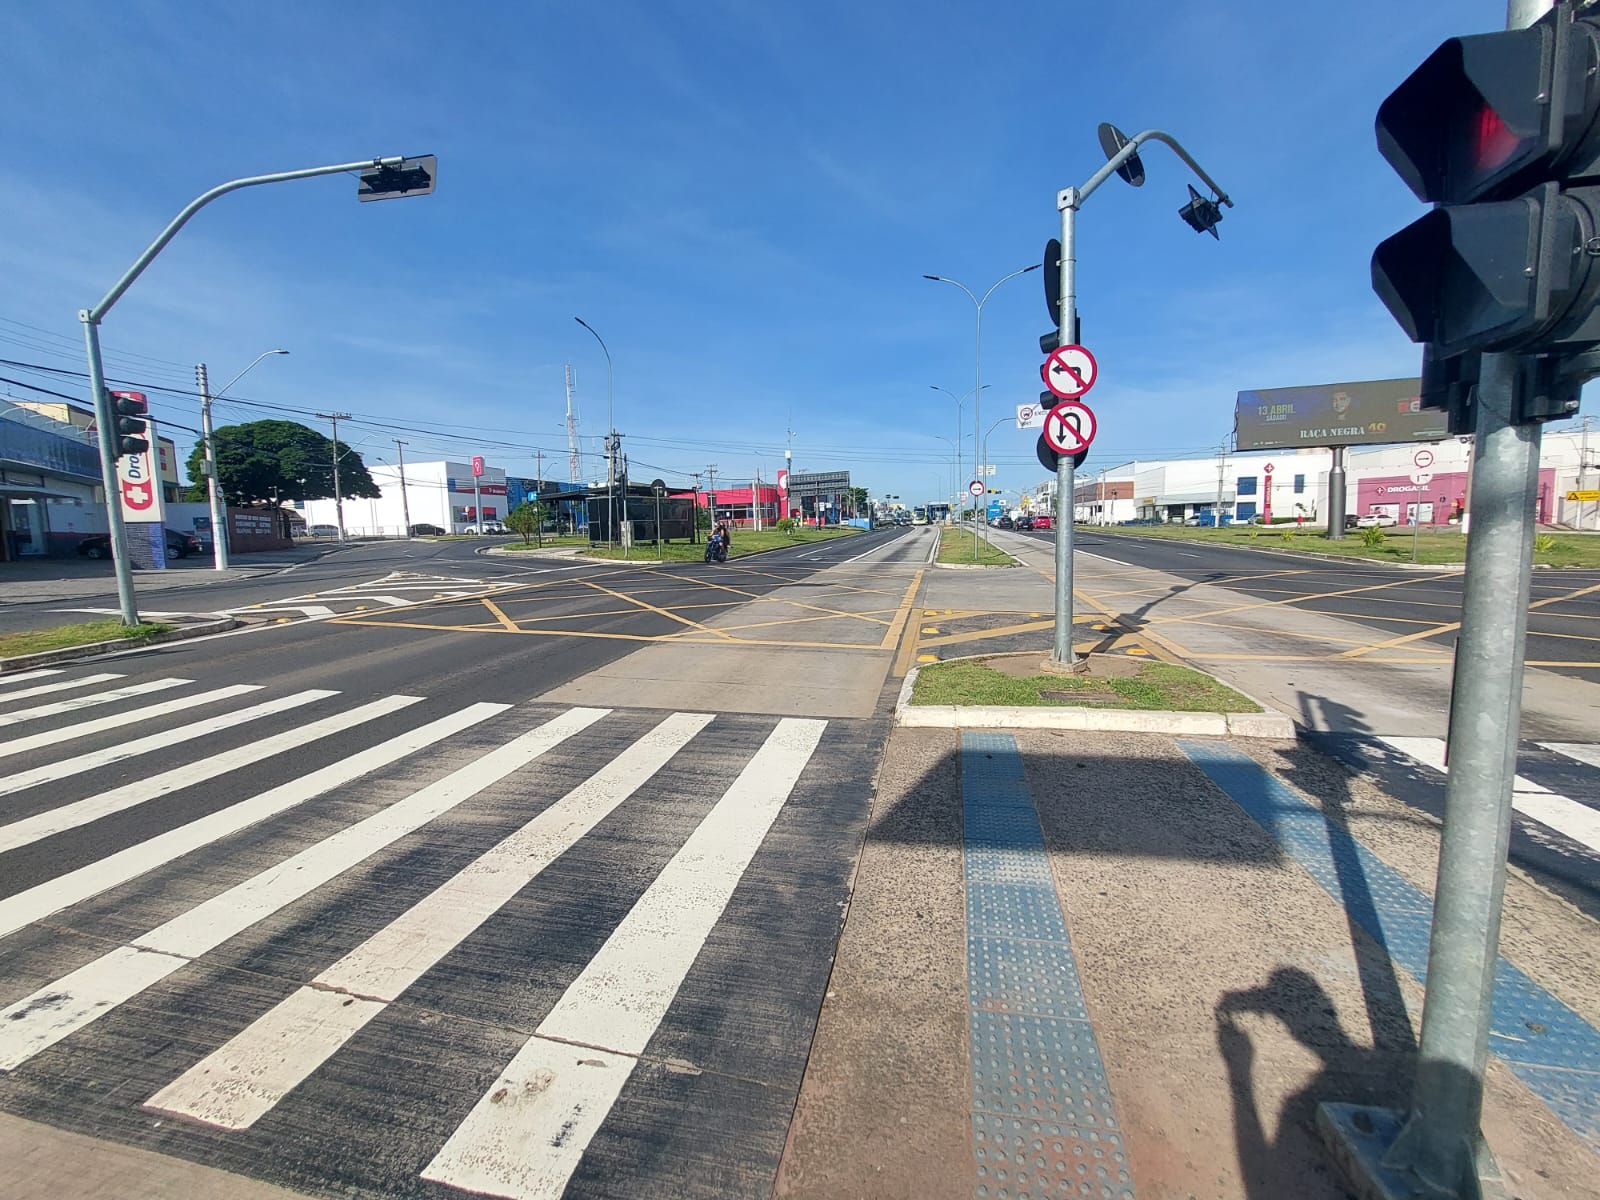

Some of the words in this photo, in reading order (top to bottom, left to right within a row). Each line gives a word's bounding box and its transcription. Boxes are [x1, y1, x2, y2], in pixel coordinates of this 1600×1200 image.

[1258, 406, 1268, 416] 13
[1271, 404, 1296, 414] ABRIL
[1330, 427, 1365, 436] NEGRA
